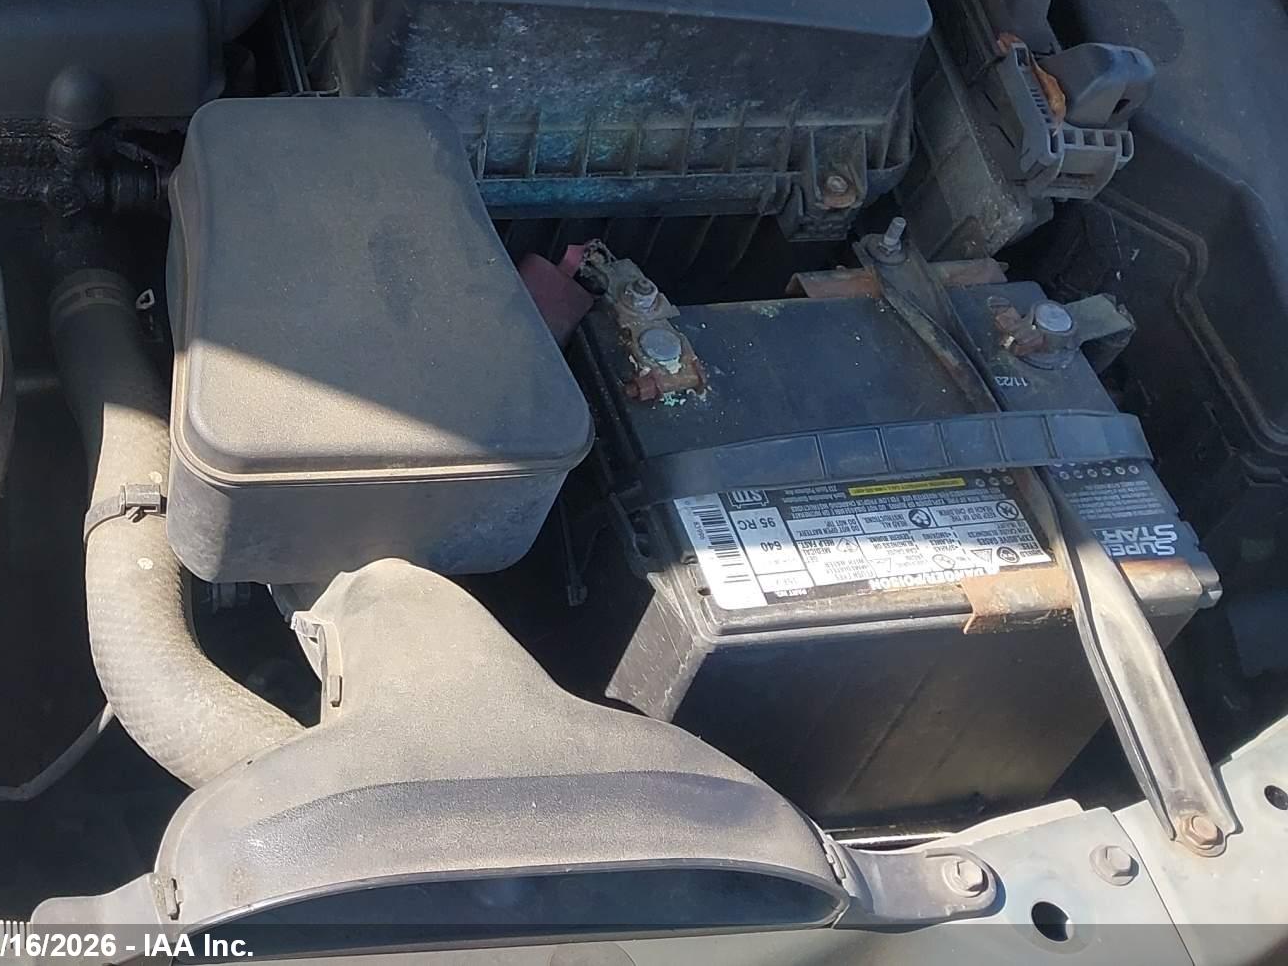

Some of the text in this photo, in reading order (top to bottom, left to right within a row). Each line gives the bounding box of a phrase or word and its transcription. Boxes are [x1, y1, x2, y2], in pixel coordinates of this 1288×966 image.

[737, 517, 776, 531] 95 RC
[1101, 523, 1177, 542] STAR
[760, 540, 782, 552] 640
